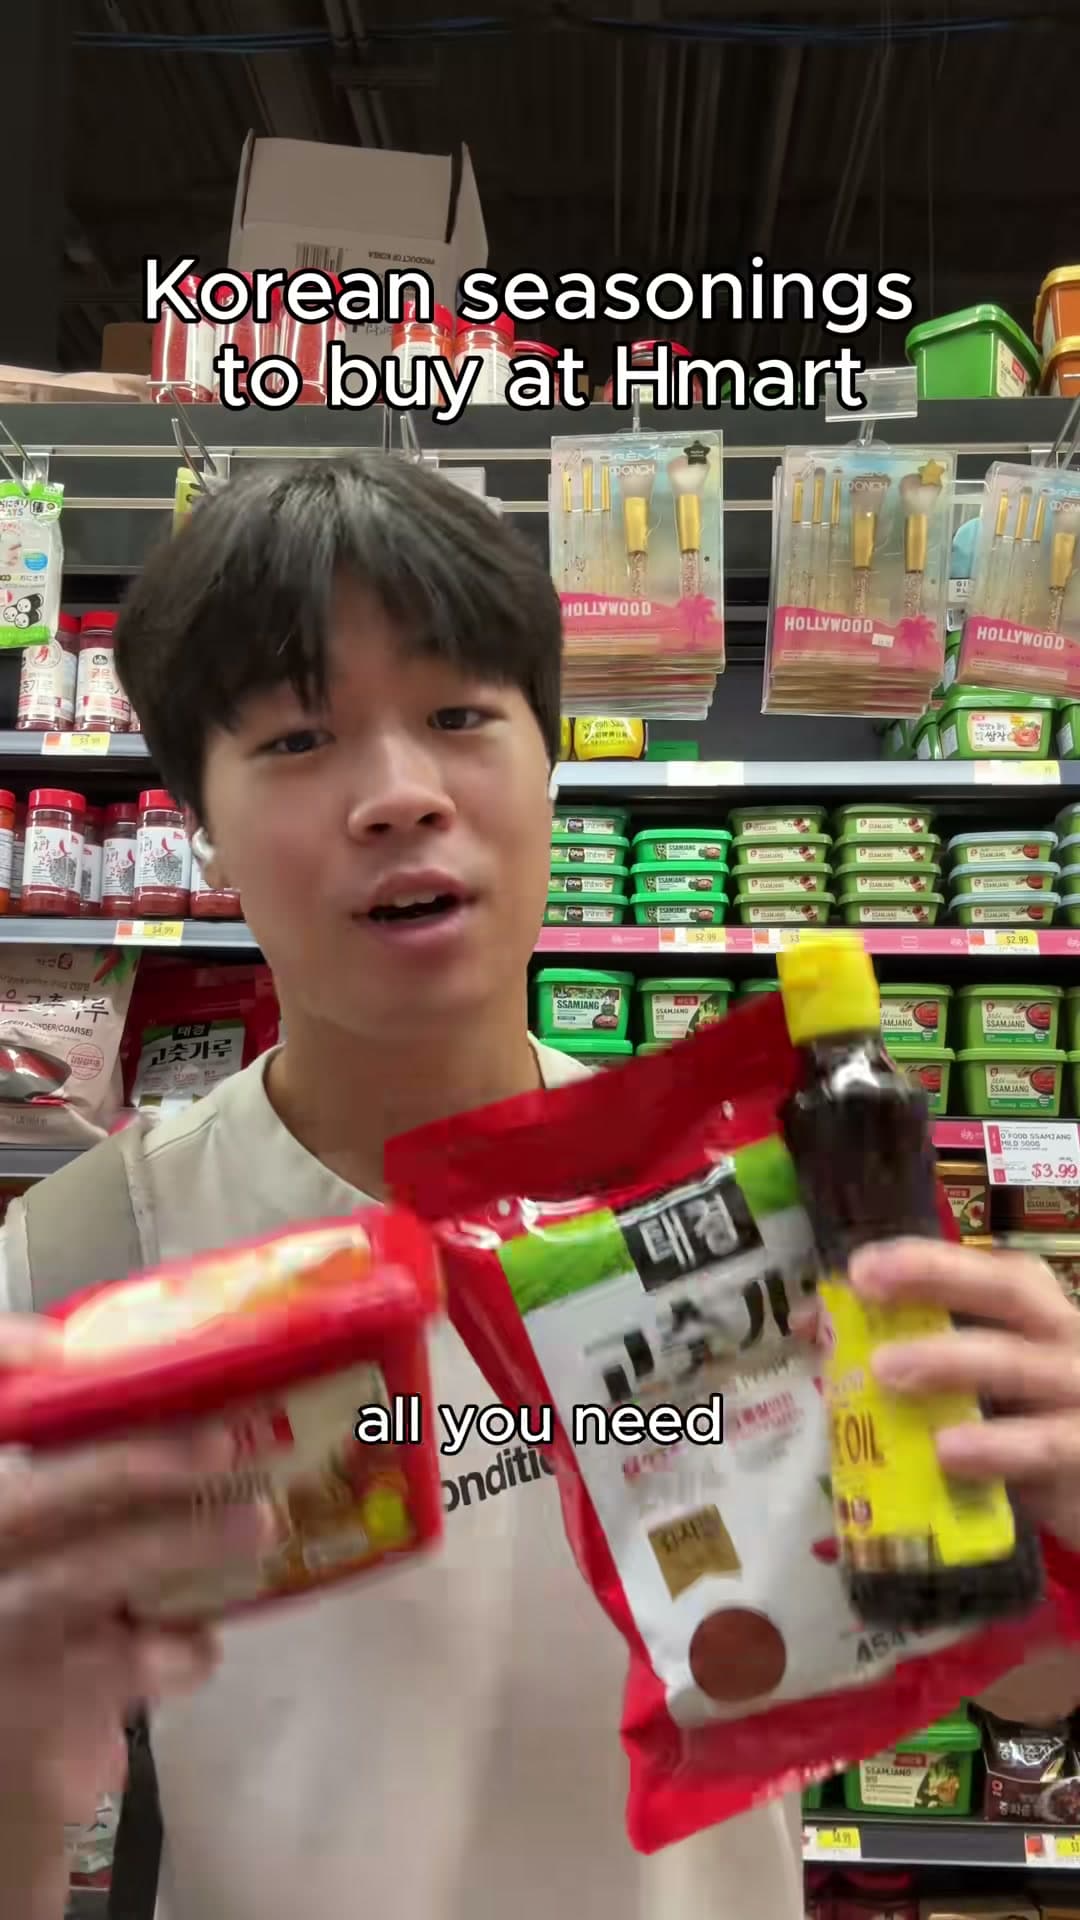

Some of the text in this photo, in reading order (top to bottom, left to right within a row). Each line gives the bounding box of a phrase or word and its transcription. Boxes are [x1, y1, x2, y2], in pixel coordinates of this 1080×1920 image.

[563, 601, 651, 616] HOLLYWOOD
[784, 615, 874, 633] HOLLYWOOD
[976, 626, 1065, 650] HOLLYWOOD
[1005, 935, 1029, 945] $2.99
[556, 999, 600, 1010] SSAMJANG
[985, 1019, 1025, 1029] SSAMJANG
[990, 1084, 1029, 1093] SSAMJANG
[1031, 1162, 1078, 1179] $3.99
[845, 1412, 886, 1468] OIL
